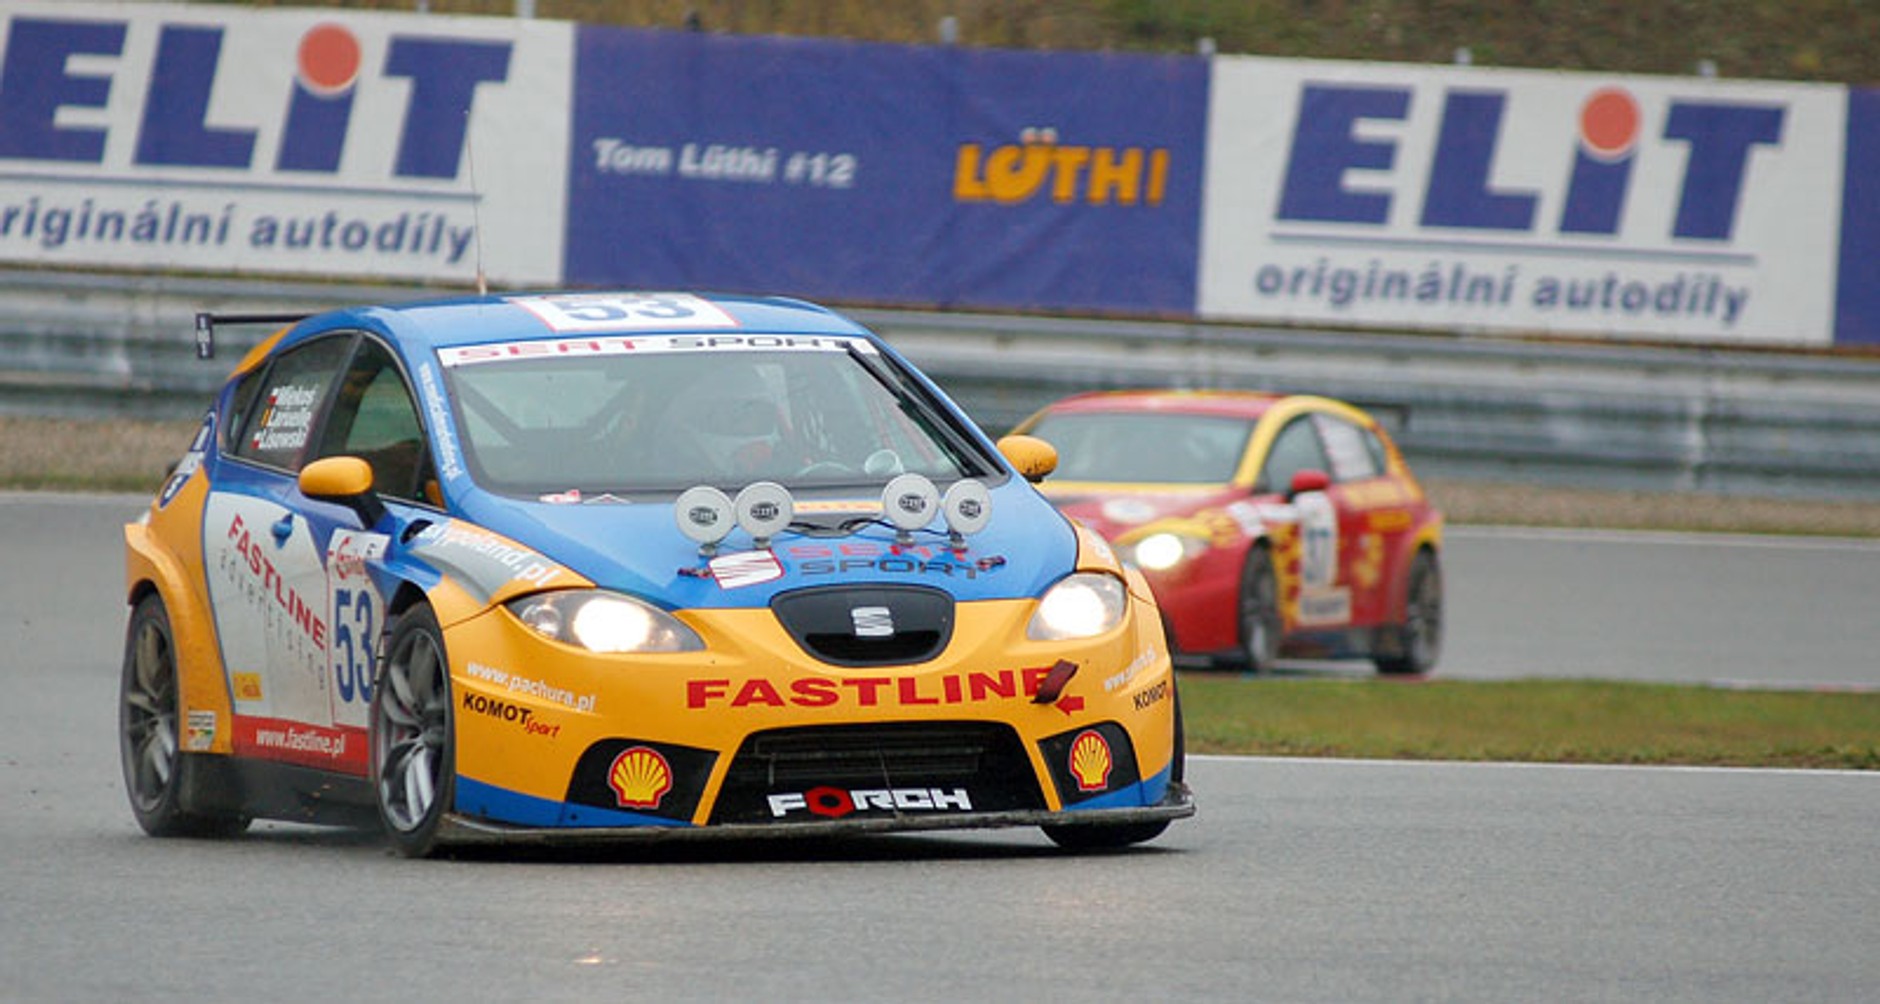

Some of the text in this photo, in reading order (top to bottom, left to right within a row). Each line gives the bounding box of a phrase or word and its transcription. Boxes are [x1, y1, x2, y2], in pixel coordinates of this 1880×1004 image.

[592, 137, 859, 188] Tom Lüthi #12
[953, 127, 1171, 206] LÜTHI
[248, 211, 475, 264] autodíly
[553, 298, 695, 321] 53
[1255, 256, 1751, 325] originální autodíly
[459, 336, 851, 361] SEAT SPORT
[788, 545, 967, 563] SEAT
[801, 557, 976, 580] SPORT
[228, 513, 327, 651] FASTLINE
[335, 588, 375, 704] 53
[467, 661, 598, 713] www.pachura.pl
[256, 727, 346, 760] www.fastline.pl
